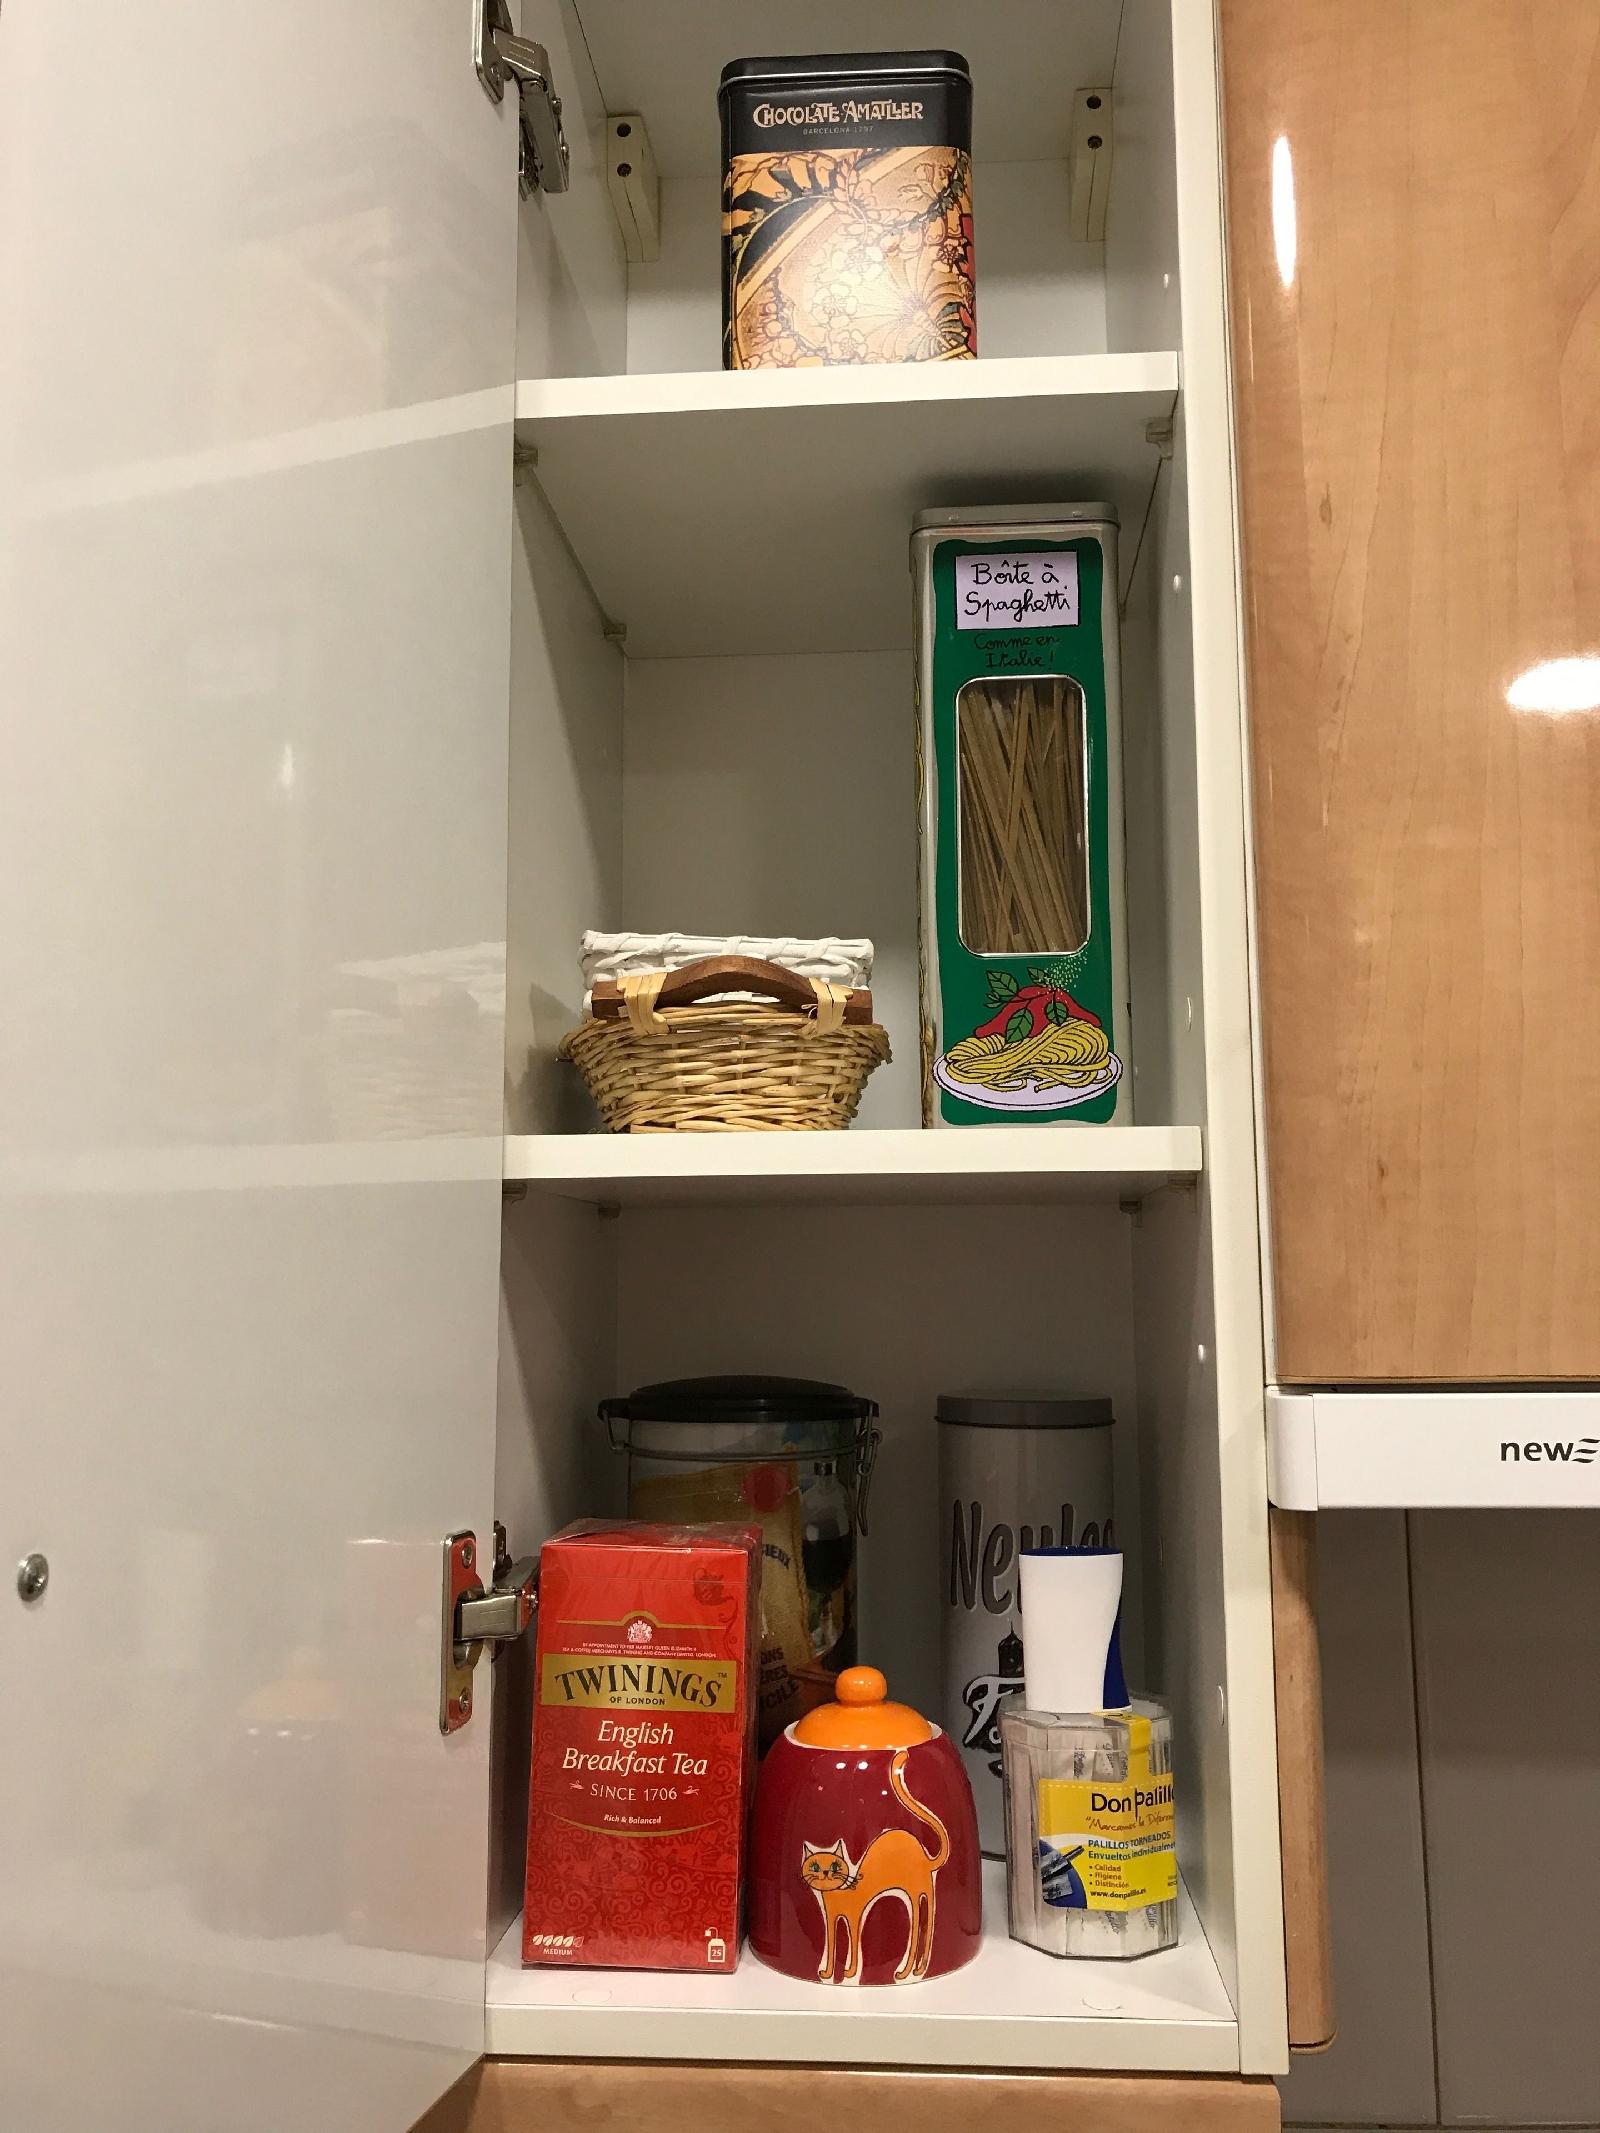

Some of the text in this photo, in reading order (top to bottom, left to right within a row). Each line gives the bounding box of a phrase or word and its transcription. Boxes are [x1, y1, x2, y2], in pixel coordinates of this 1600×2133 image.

[753, 99, 924, 128] CHOCOLATE AMATLLER
[803, 127, 849, 136] BARCELONA
[1041, 563, 1060, 584] à
[964, 585, 1071, 623] Spaghetti
[973, 632, 1032, 650] Comme
[555, 1663, 722, 1708] TWININGS
[609, 1696, 666, 1706] OF LONDON
[597, 1719, 674, 1748] English
[561, 1747, 708, 1777] Breakfast Tea
[590, 1783, 678, 1802] SINCE 1706
[604, 1813, 662, 1825] Rich & Balanced
[1088, 1831, 1171, 1850] PALILLOS TORNEADOS
[1088, 1850, 1131, 1861] Envueltos
[1094, 1863, 1122, 1872] Calidad
[1094, 1871, 1122, 1881] Higiene
[1094, 1879, 1130, 1889] Distinción
[543, 1947, 573, 1956] MEDIUM
[711, 1949, 722, 1957] 25
